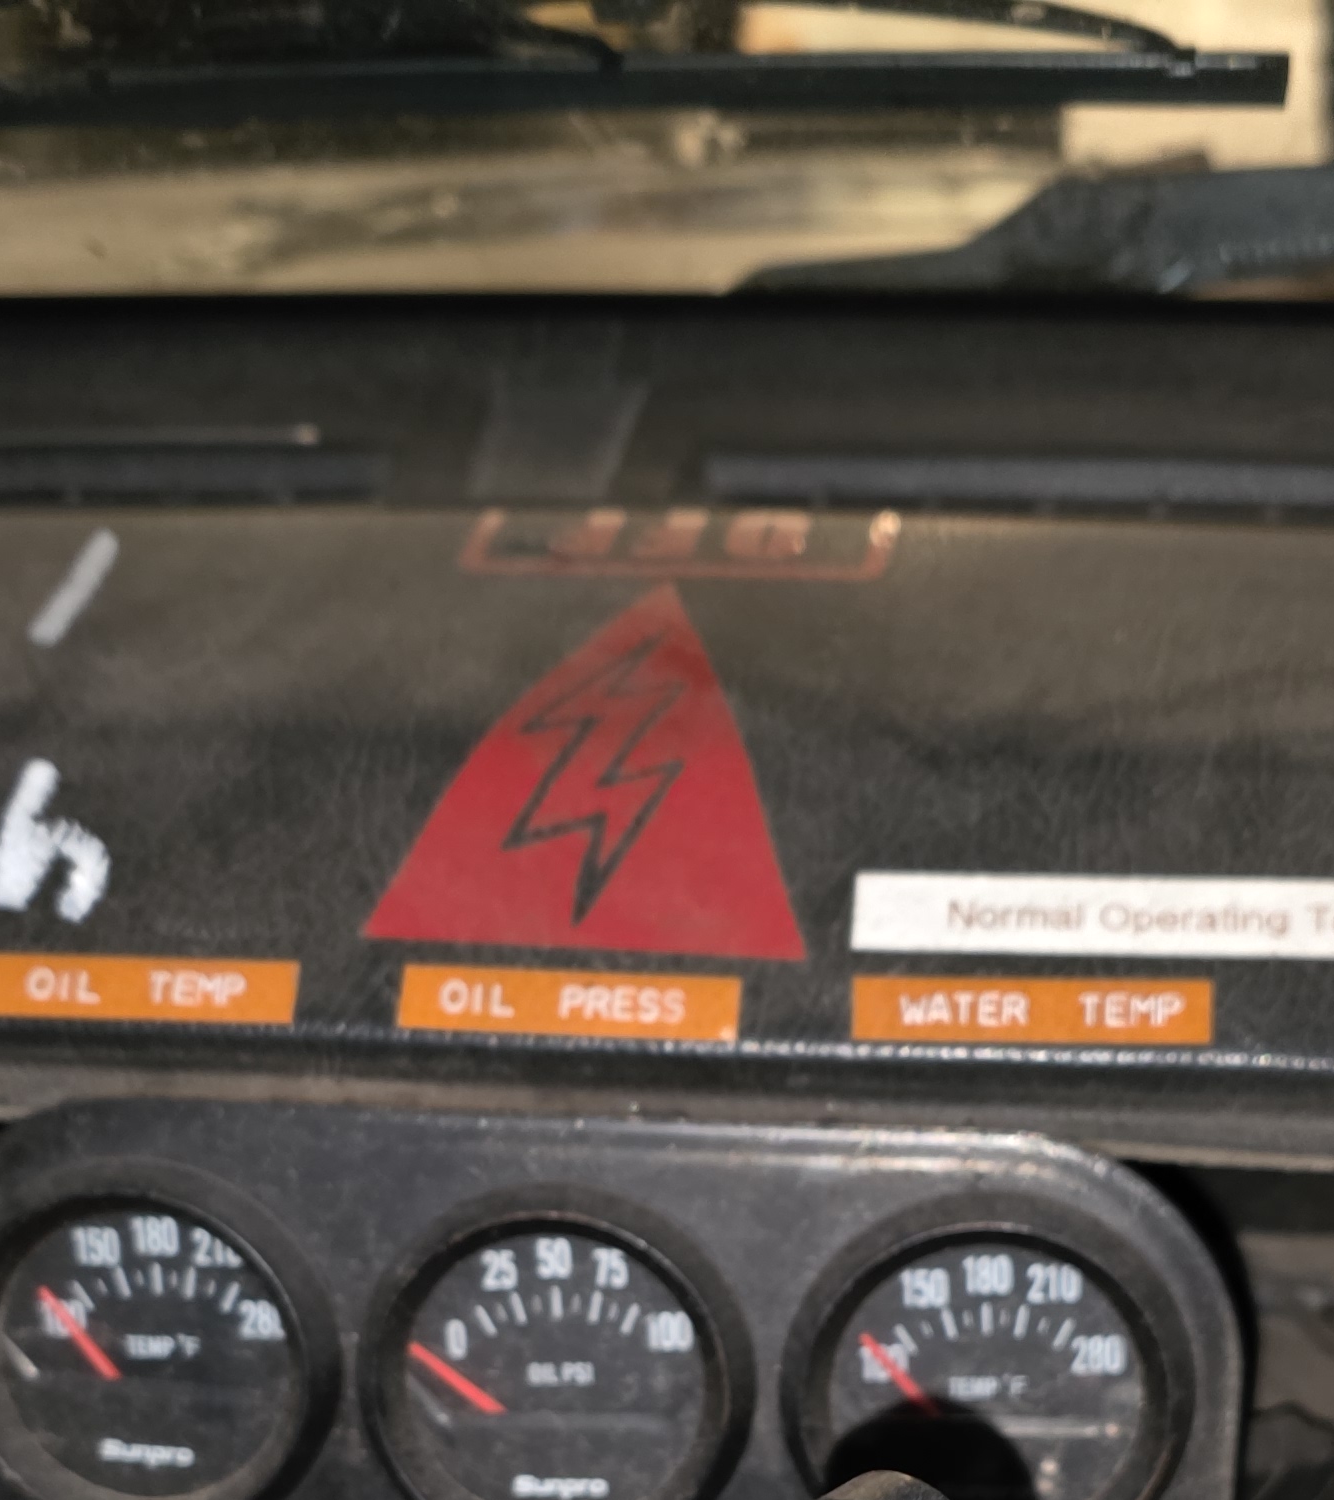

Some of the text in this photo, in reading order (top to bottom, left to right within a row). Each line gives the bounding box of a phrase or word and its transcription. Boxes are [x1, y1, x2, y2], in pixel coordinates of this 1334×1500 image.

[947, 899, 1083, 933] Normal
[1099, 902, 1291, 939] Operating
[24, 965, 247, 1008] OIL TEMP
[439, 978, 686, 1025] OIL PRESS
[898, 990, 1186, 1029] WATER TEMP
[72, 1226, 121, 1266] 150
[130, 1216, 180, 1256] 180
[481, 1249, 518, 1290] 25
[535, 1237, 572, 1279] 50
[592, 1248, 629, 1288] 75
[962, 1254, 1014, 1295] 180
[899, 1267, 951, 1308] 150
[1027, 1263, 1083, 1303] 210
[444, 1318, 467, 1360] 0
[646, 1311, 695, 1352] 100
